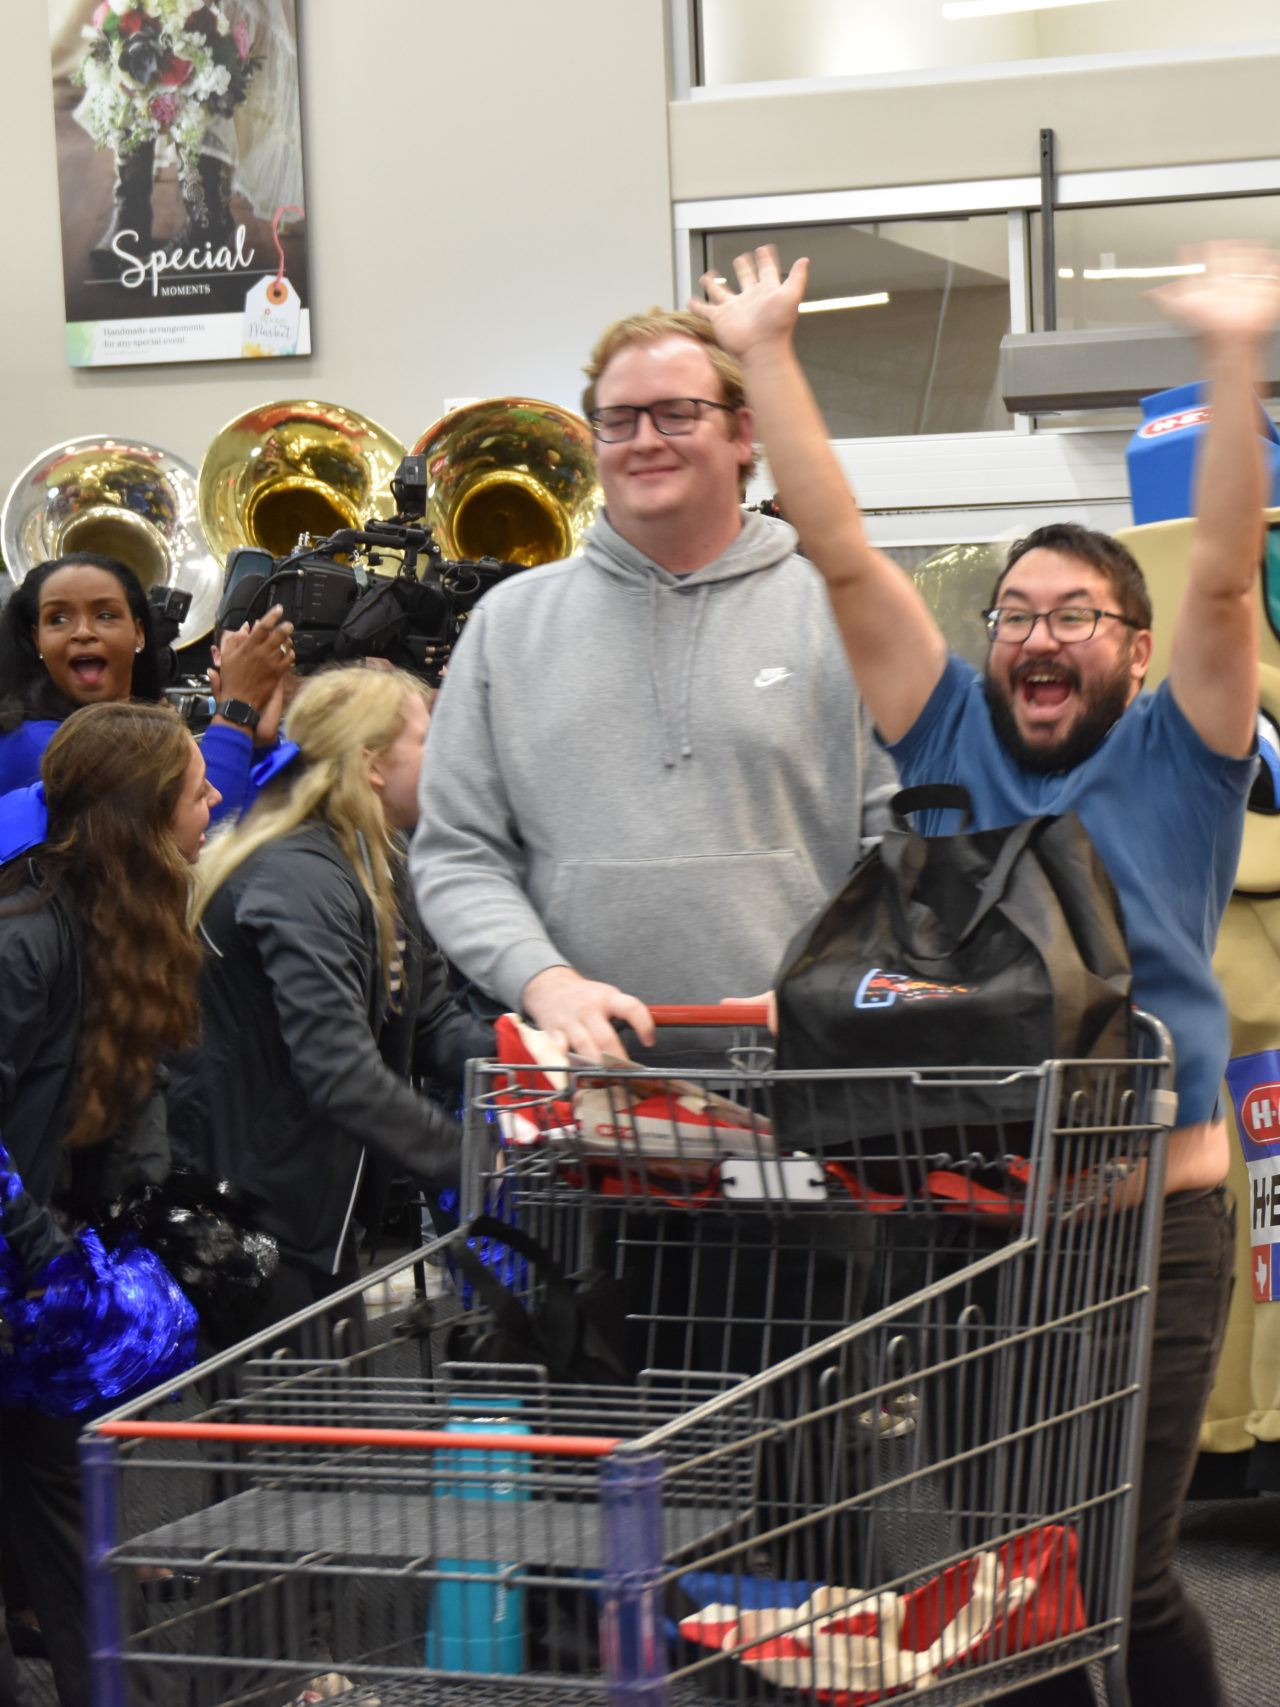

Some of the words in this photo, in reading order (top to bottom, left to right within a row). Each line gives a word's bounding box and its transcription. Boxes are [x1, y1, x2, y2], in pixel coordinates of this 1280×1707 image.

[112, 224, 255, 297] Special
[161, 284, 211, 297] MOMENTS
[103, 326, 146, 336] Handmade
[148, 323, 206, 335] arrangements
[104, 339, 115, 348] for
[117, 339, 132, 348] any
[133, 337, 161, 348] special
[163, 336, 185, 345] event
